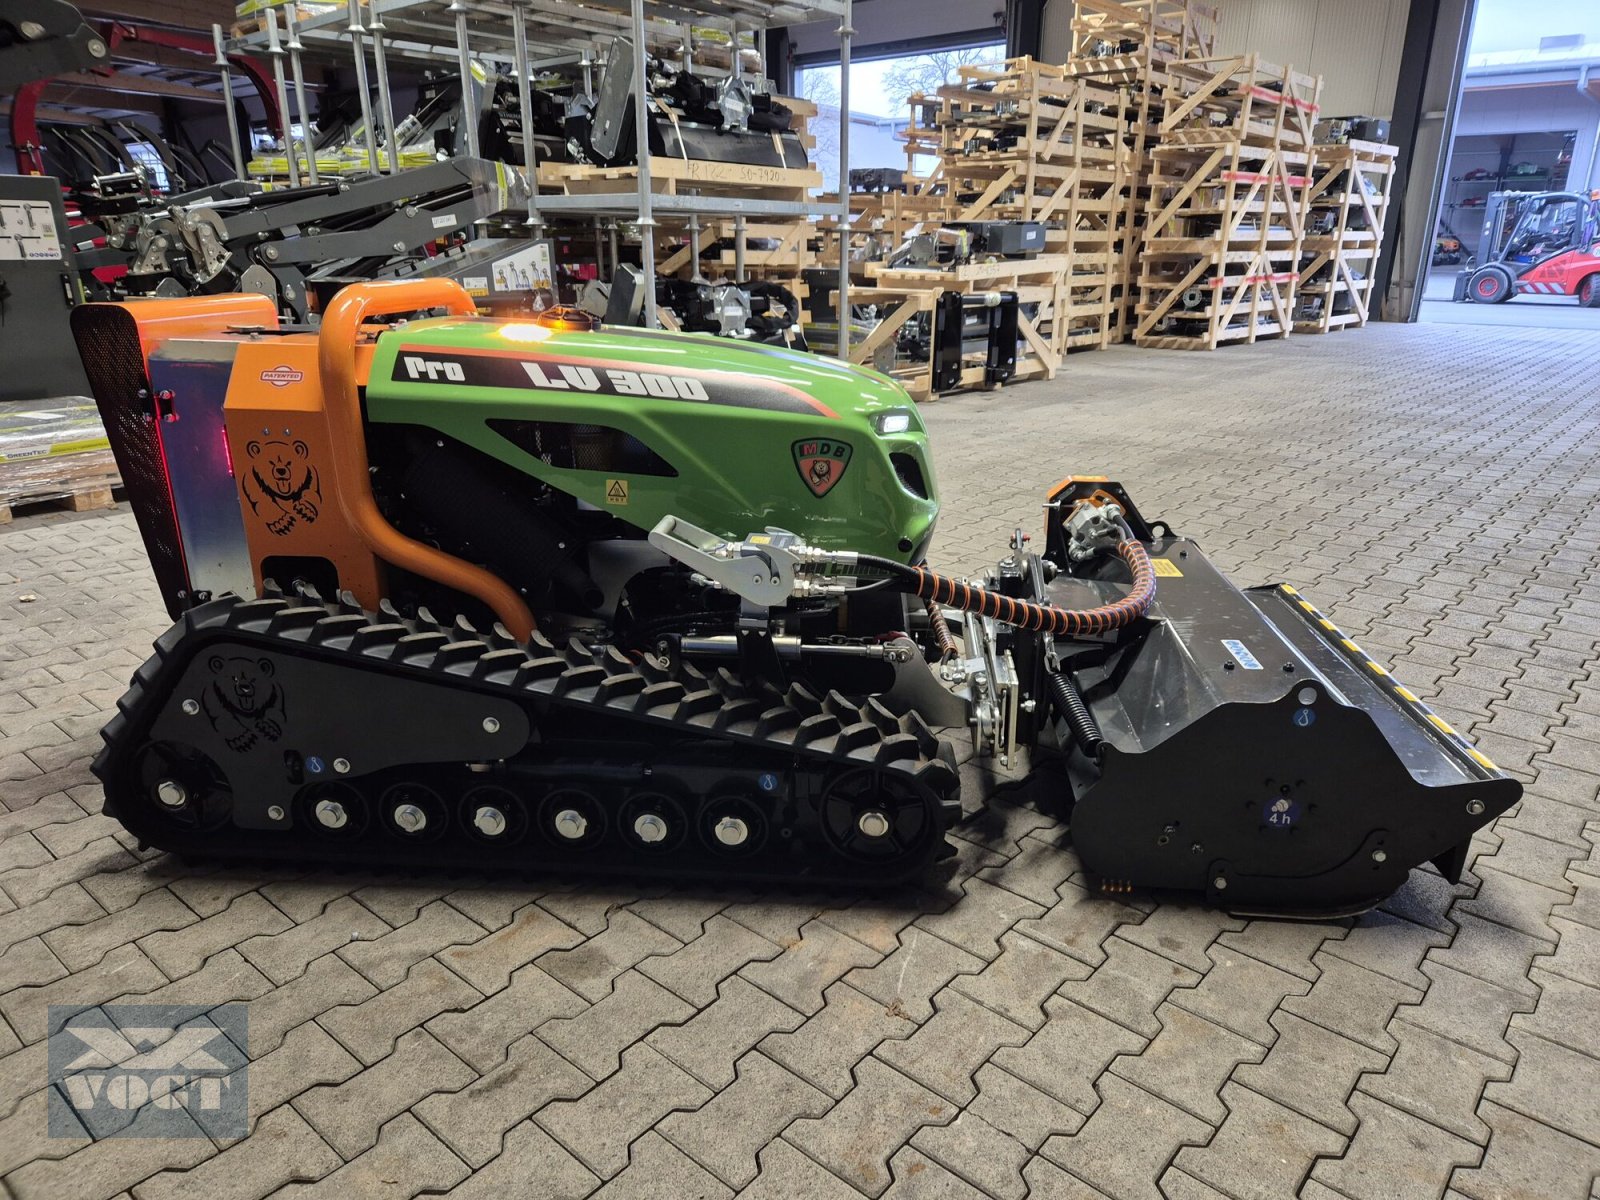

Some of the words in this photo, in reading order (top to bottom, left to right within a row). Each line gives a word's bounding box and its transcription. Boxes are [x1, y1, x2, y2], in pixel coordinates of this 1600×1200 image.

[403, 356, 466, 381] Pro
[520, 362, 601, 391] LV
[605, 369, 710, 401] 300
[799, 441, 846, 458] MDB
[1269, 813, 1278, 824] 4
[1282, 813, 1291, 824] h
